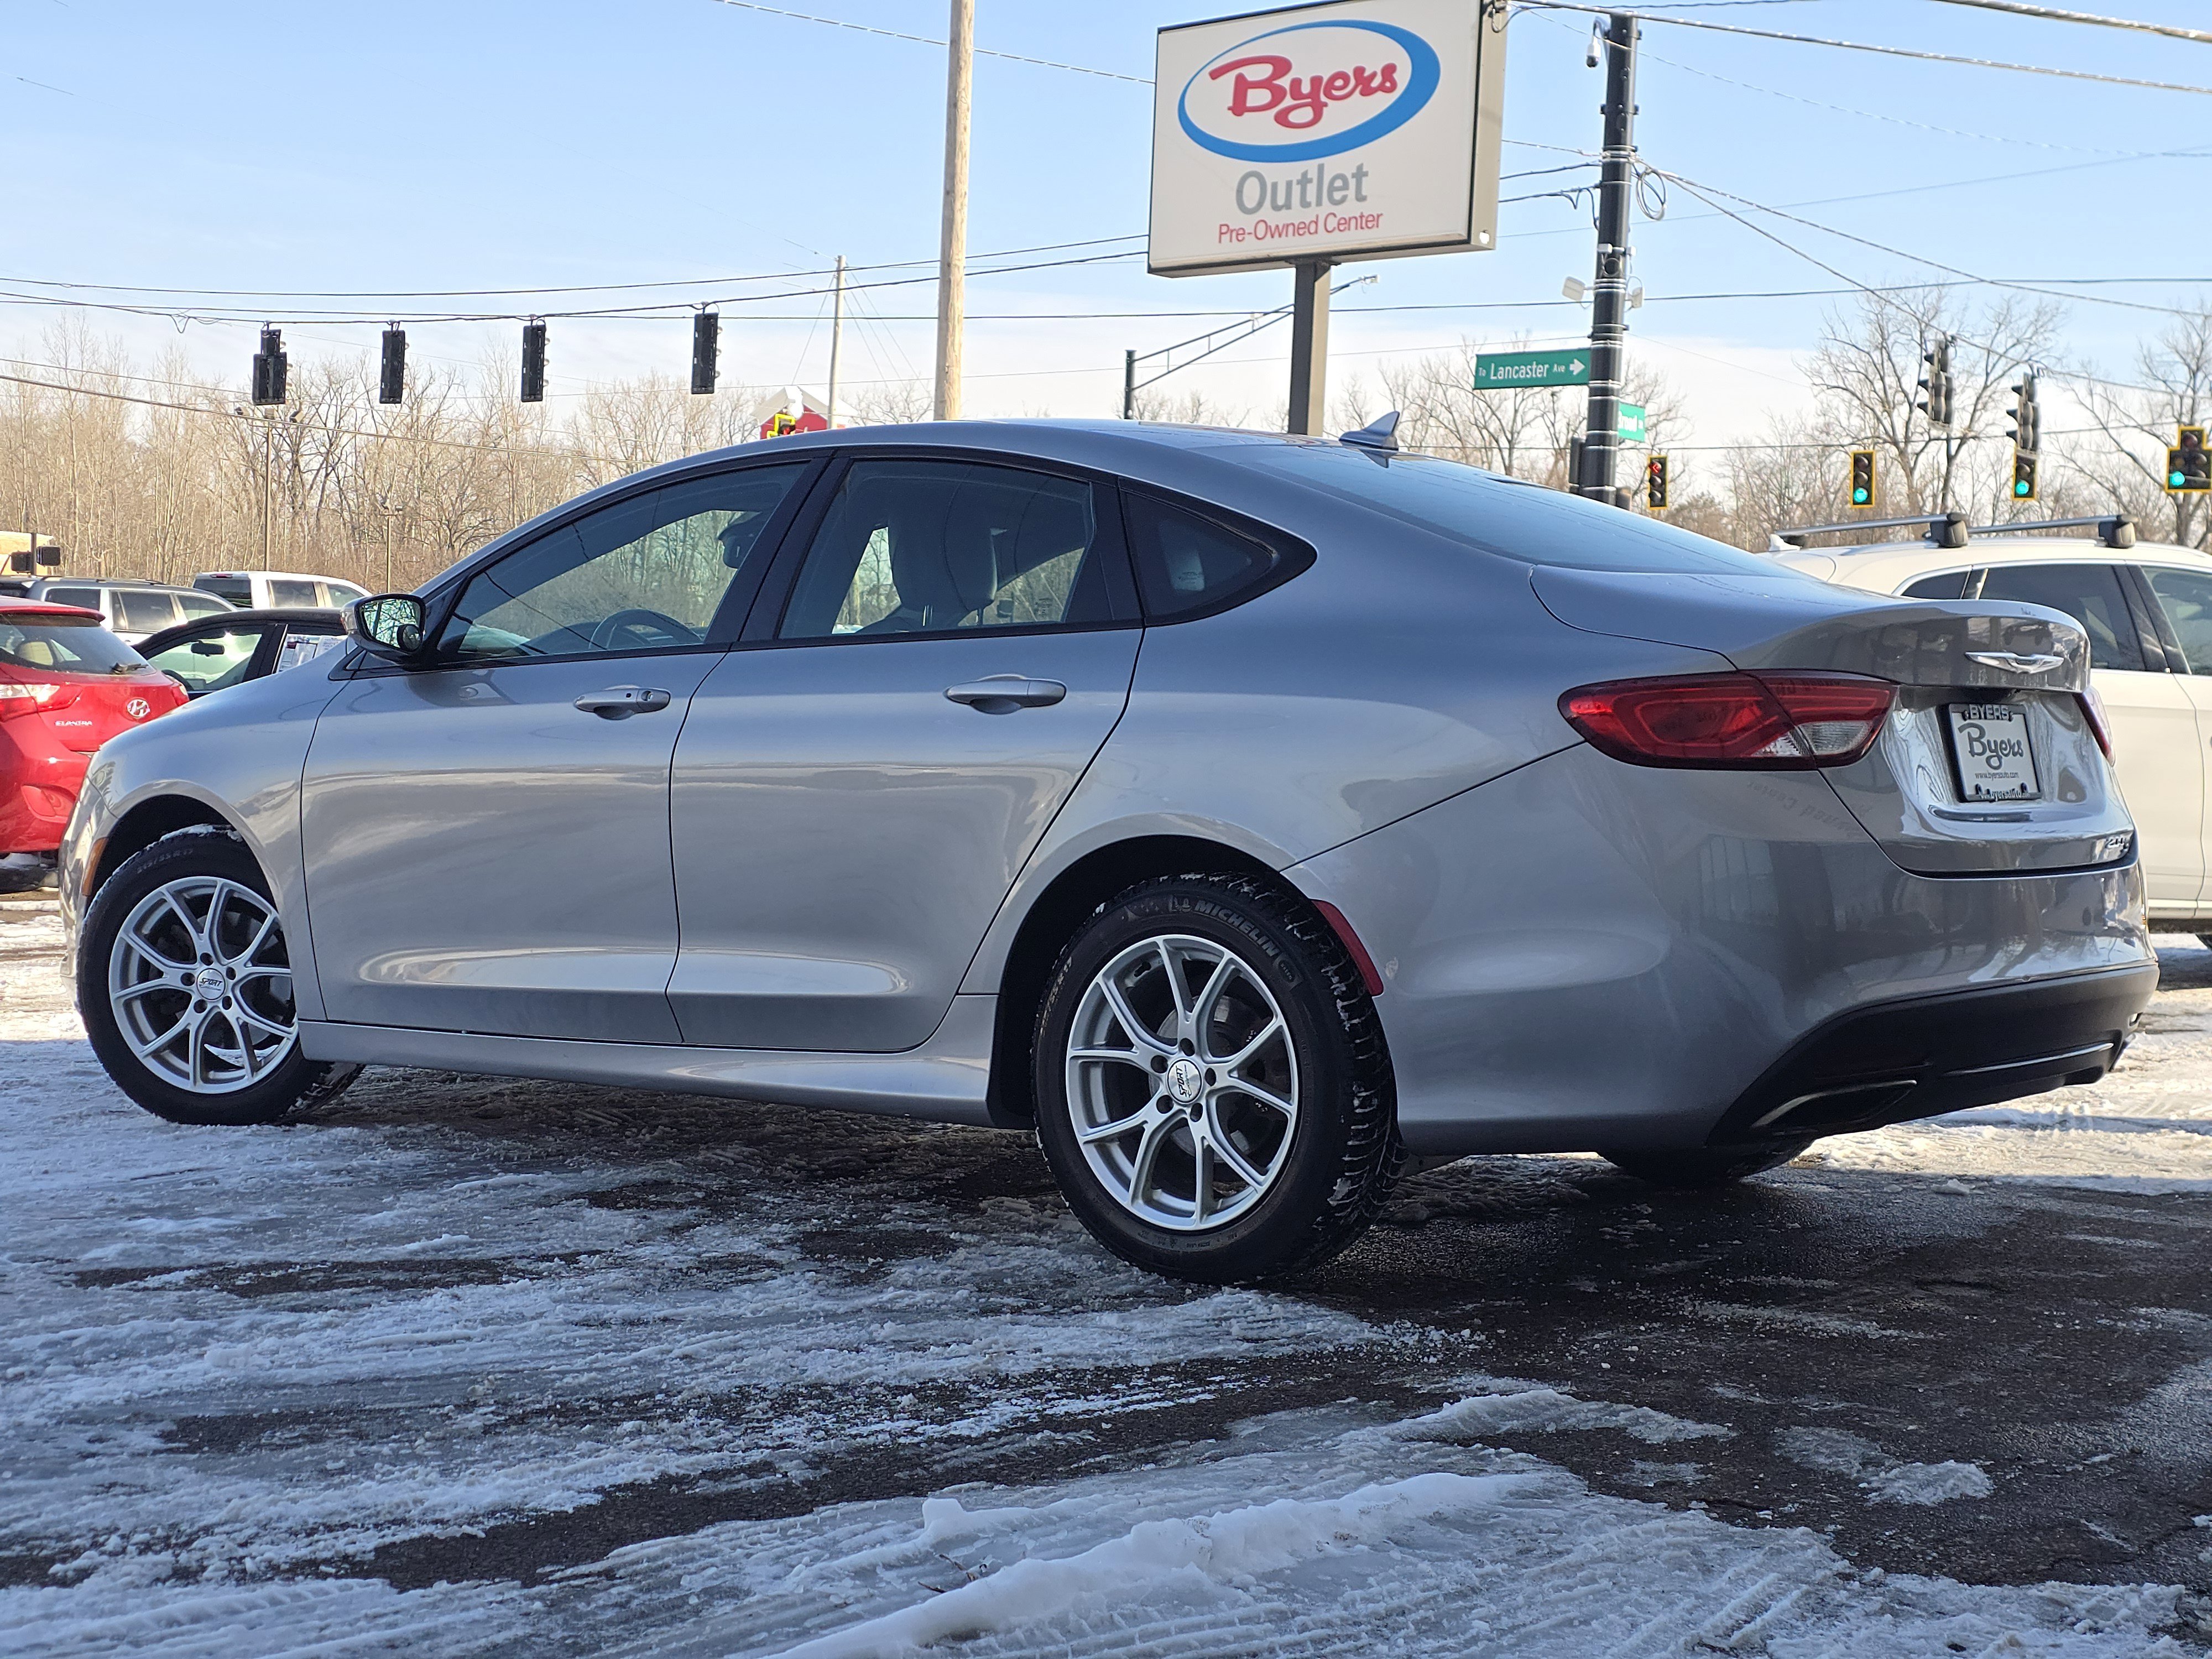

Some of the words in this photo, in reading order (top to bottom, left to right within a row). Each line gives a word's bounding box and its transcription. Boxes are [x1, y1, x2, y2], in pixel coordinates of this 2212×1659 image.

[1208, 55, 1398, 129] Byers
[1235, 163, 1369, 215] Outlet
[1218, 214, 1319, 244] Pre-Owned
[1323, 211, 1384, 235] Center
[1478, 367, 1486, 377] To
[1490, 361, 1549, 380] Lancaster
[1553, 363, 1566, 373] Ave
[1969, 703, 2009, 720] BYERS
[1958, 722, 2024, 770] Byers
[1194, 900, 1281, 957] MICHELIN
[1175, 1065, 1187, 1098] SPORT
